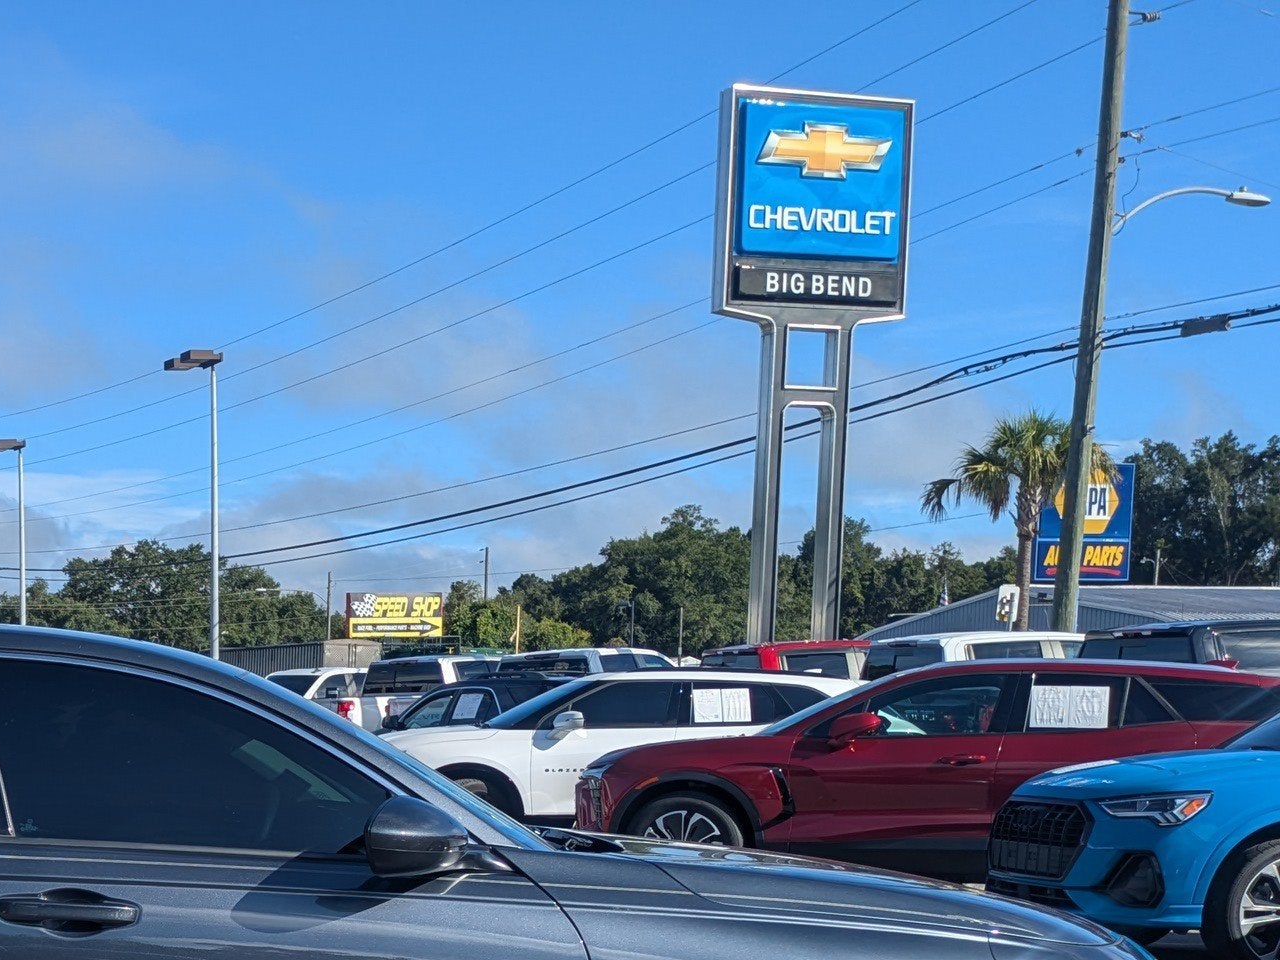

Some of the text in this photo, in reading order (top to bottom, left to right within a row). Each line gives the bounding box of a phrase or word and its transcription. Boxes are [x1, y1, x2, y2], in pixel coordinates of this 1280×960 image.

[748, 204, 896, 235] CHEVROLET
[766, 271, 873, 298] BIG BEND
[1082, 545, 1125, 567] PARTS
[372, 596, 441, 617] SPEED SHOP
